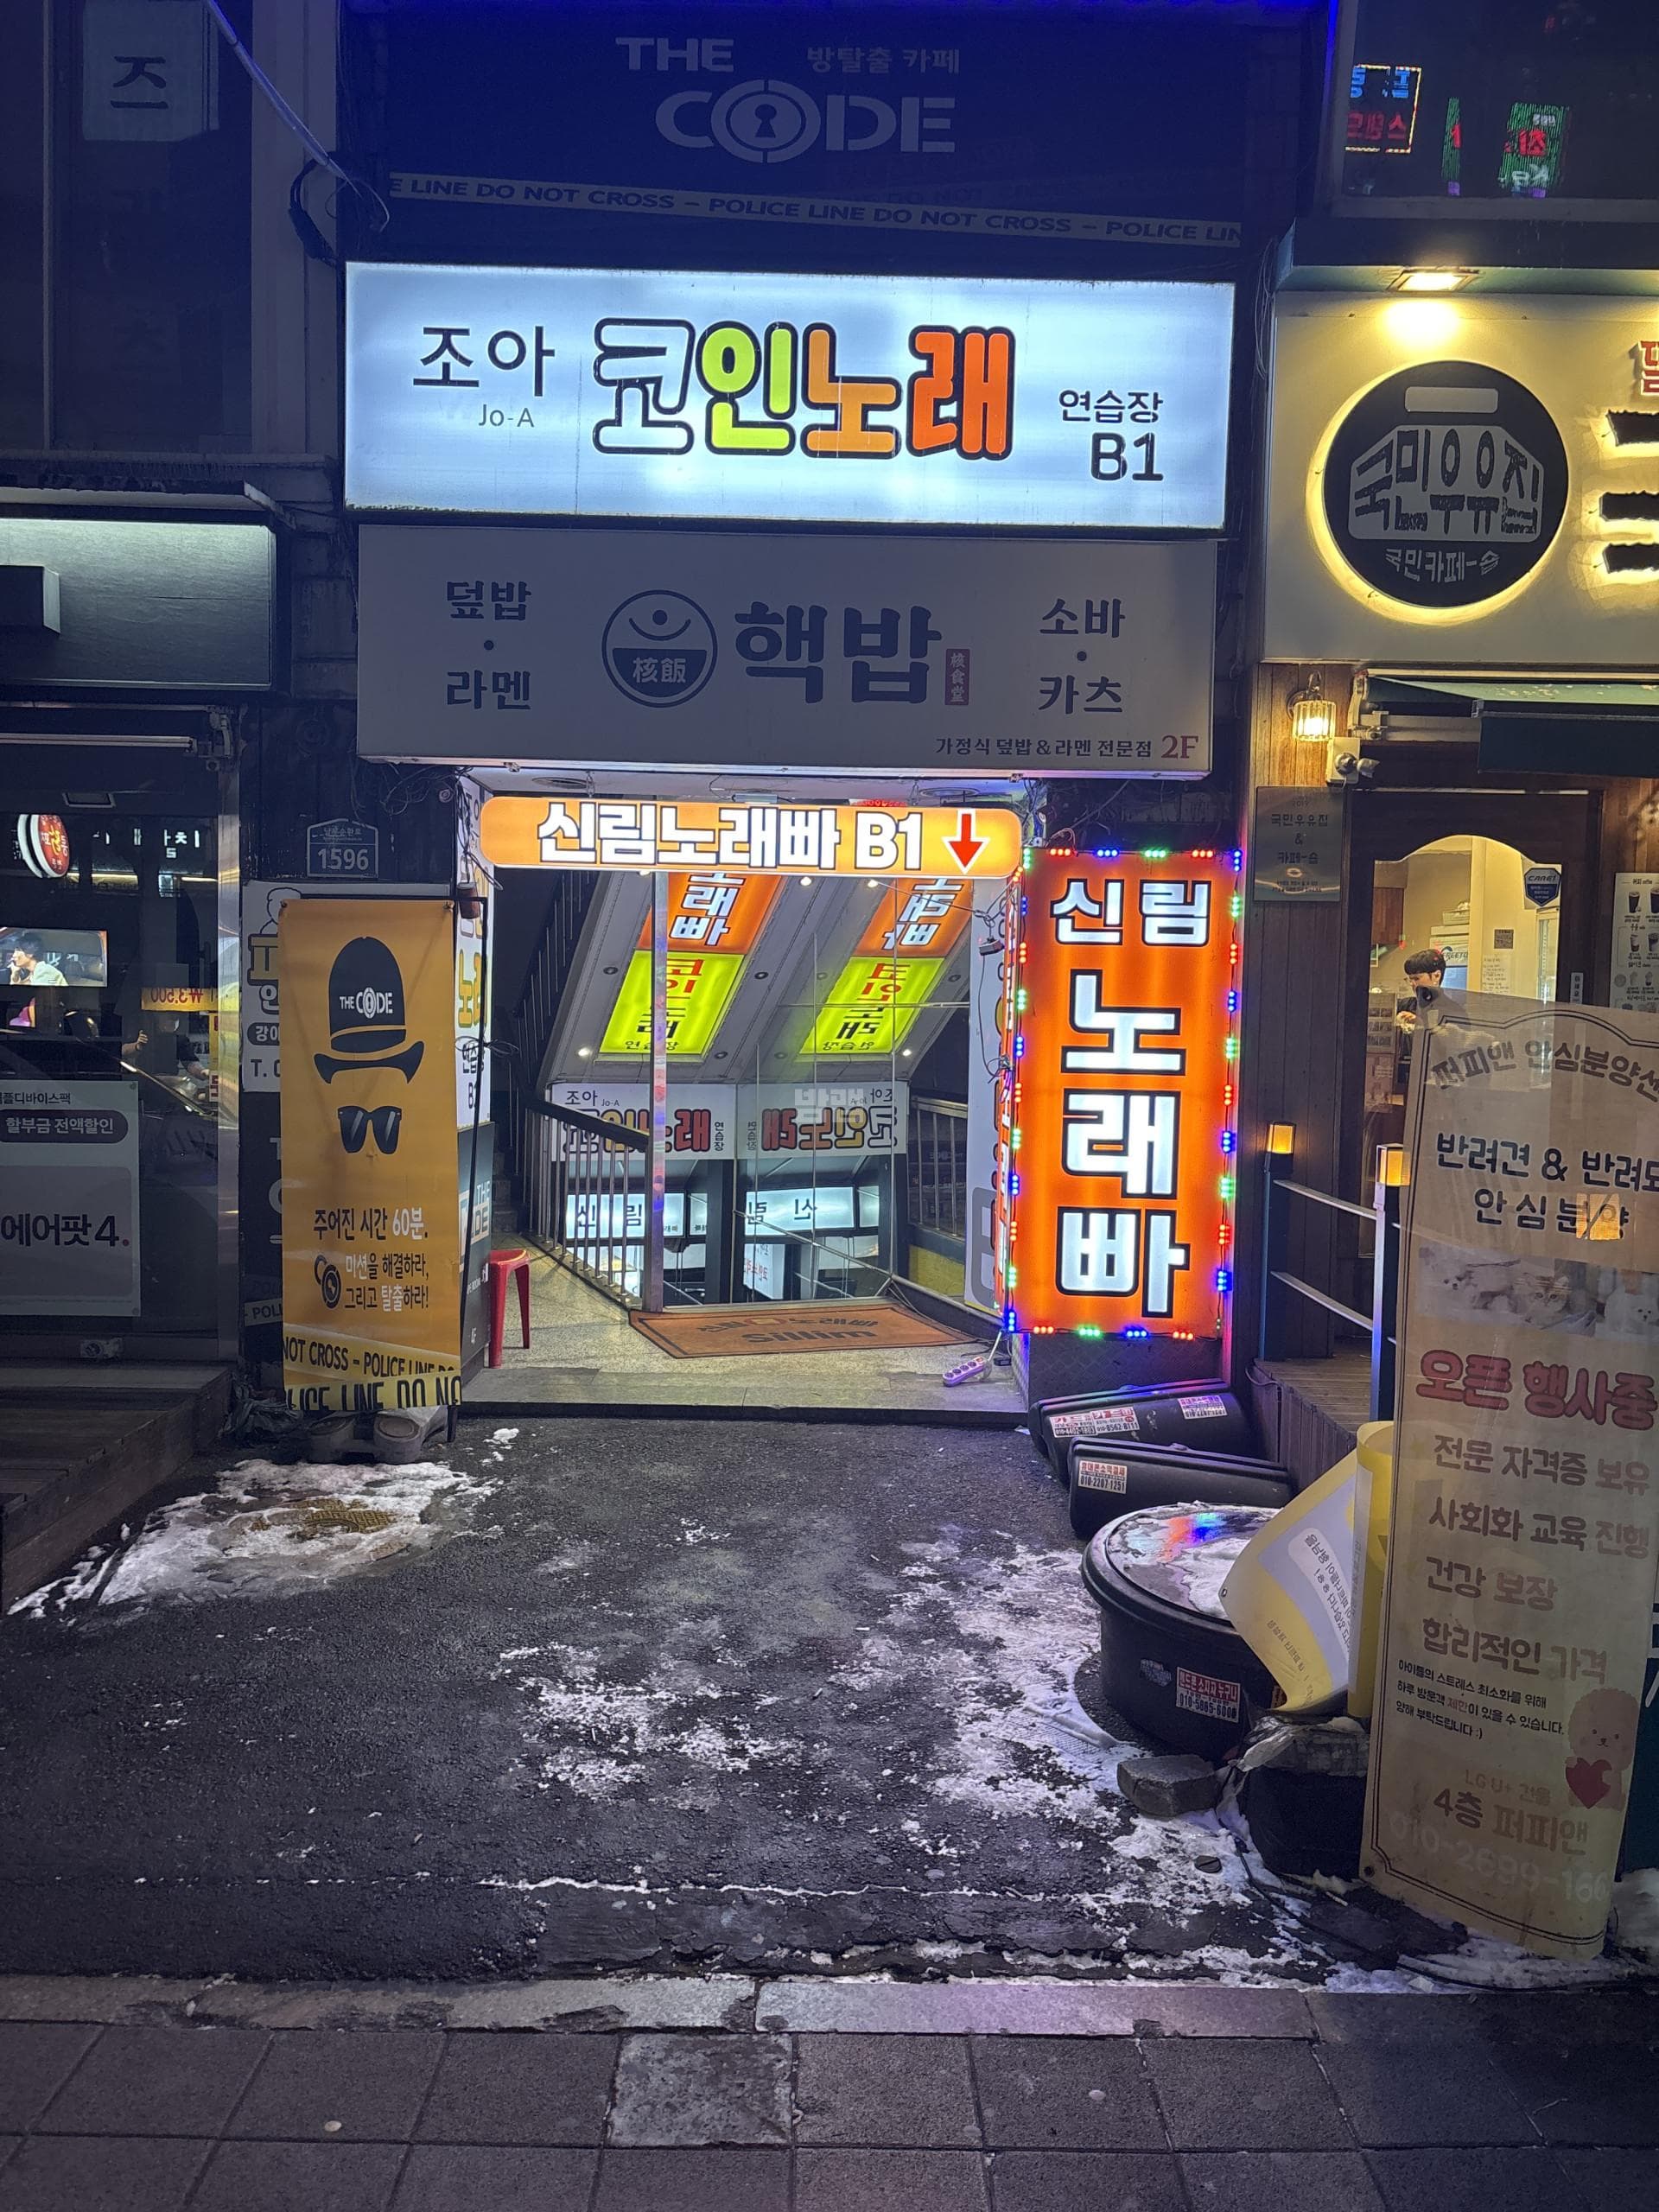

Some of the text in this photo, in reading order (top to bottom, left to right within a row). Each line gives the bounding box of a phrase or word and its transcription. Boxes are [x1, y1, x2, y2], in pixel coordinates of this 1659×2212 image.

[616, 37, 734, 72] THE
[807, 47, 959, 74] 방탈출 카페
[655, 79, 956, 162] CODE
[411, 180, 467, 196] LINE
[476, 183, 515, 200] DO
[524, 186, 580, 202] NOT
[588, 189, 675, 208] CROSS
[709, 197, 800, 217] POLICE
[808, 203, 865, 221] LINE
[873, 207, 912, 224] DO
[920, 210, 977, 227] NOT
[985, 214, 1071, 232] CROSS
[1105, 221, 1198, 239] POLICE
[413, 317, 1164, 461] 조아 코인노래 연습장
[478, 404, 535, 428] Jo-A
[1090, 431, 1164, 481] B1
[447, 581, 531, 621] 덮밥
[1039, 598, 1125, 639] 소바
[632, 657, 687, 684] 核飯
[734, 601, 942, 703] 핵밥
[447, 671, 531, 710] 라멘
[1038, 676, 1123, 715] 카츠
[936, 737, 990, 756] 가정식
[1097, 741, 1151, 758] 전문점
[1161, 734, 1198, 759] 2F
[537, 801, 841, 870] 신림노래빠
[855, 811, 922, 870] B1
[317, 849, 369, 871] 1596
[1050, 878, 1212, 946] 신림
[340, 988, 393, 1018] THE CODE
[565, 1090, 598, 1106] 조아
[6, 1118, 113, 1135] 할부금 전액할인
[1056, 969, 1191, 1318] 노래빠
[1437, 1133, 1529, 1178] 반려견
[1541, 1148, 1568, 1181] &
[1, 1213, 90, 1247] 에어팟
[313, 1207, 429, 1240] 주어진 시간 60분.
[346, 1253, 429, 1281] 미션을 해결하라,
[345, 1286, 429, 1312] 그리고 탈출하라!
[743, 1329, 878, 1344] Sillim
[309, 1342, 348, 1371] CROSS
[364, 1351, 405, 1377] POLICE
[396, 1377, 426, 1408] DO
[1416, 1350, 1658, 1431] 오픈 행사중
[1434, 1434, 1650, 1496] 전문 자격증 보유
[1429, 1497, 1649, 1560] 사회화 교육 진행
[1427, 1556, 1558, 1611] 건강 보장
[1423, 1618, 1607, 1684] 합리적인 가격
[1399, 1659, 1547, 1708] 아이들의 스트레스 최소화를 위해
[1396, 1700, 1414, 1716] 양해
[1416, 1709, 1473, 1737] 부탁드립니다
[1397, 1681, 1565, 1735] 하루 방문객 제한이 있을 수 있습니다.
[1433, 1789, 1588, 1855] 4층 퍼피앤
